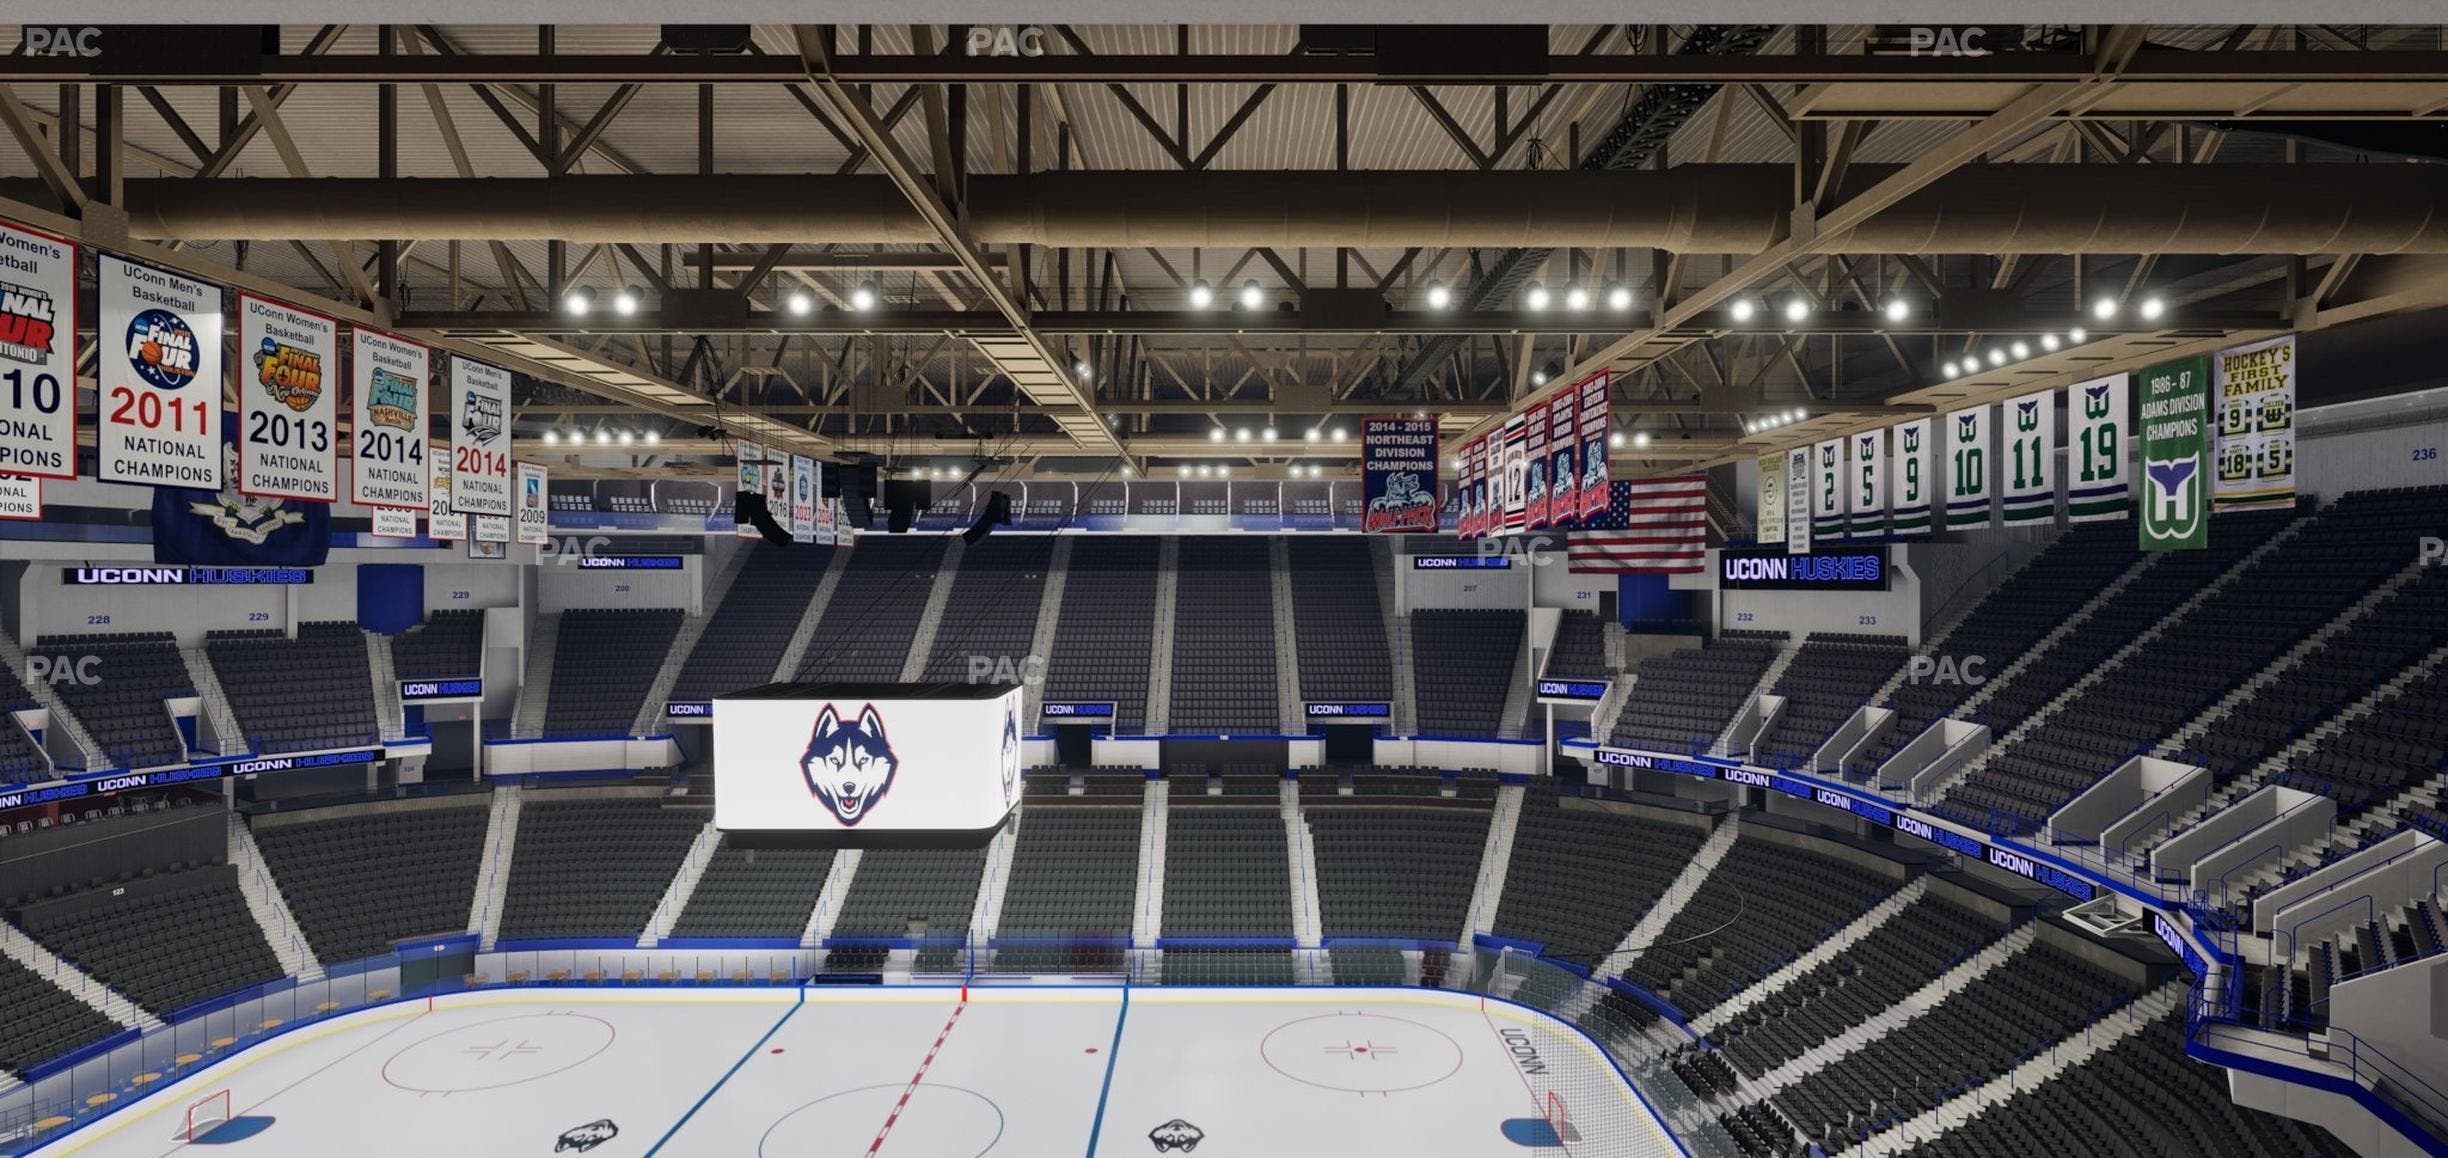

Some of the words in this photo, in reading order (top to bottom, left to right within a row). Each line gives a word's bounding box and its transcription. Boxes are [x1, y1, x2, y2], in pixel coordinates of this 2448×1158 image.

[123, 264, 166, 287] UConn
[169, 277, 203, 297] Men's
[132, 286, 195, 312] Basketball
[250, 302, 284, 320] UConn
[286, 312, 328, 333] Women's
[148, 324, 192, 351] FINAL
[265, 323, 314, 345] Basketball
[360, 334, 388, 349] UConn
[389, 342, 422, 359] Women's
[280, 347, 320, 373] FINAL
[372, 351, 412, 370] Basketball
[2224, 346, 2291, 373] HOCKEY'S
[2230, 364, 2283, 383] FIRST
[2223, 375, 2289, 397] FAMILY
[110, 386, 208, 436] 2011
[2141, 399, 2168, 420] ADAMS
[2169, 392, 2205, 416] DIVISION
[1369, 422, 1396, 432] 2014
[1405, 422, 1431, 432] 2015
[2230, 408, 2240, 428] 9
[250, 410, 328, 452] 2013
[1366, 435, 1434, 445] NORTHEAST
[2146, 418, 2198, 442] CHAMPIONS
[124, 435, 206, 459] NATIONAL
[360, 429, 423, 465] 2014
[1375, 448, 1425, 458] DIVISION
[2080, 422, 2117, 482] 19
[2412, 448, 2437, 461] 236
[260, 453, 323, 473] NATIONAL
[456, 446, 506, 478] 2014
[1367, 461, 1434, 471] CHAMPIONS
[2013, 436, 2043, 489] 11
[2226, 453, 2244, 473] 18
[2269, 449, 2280, 469] 5
[114, 459, 213, 483] CHAMPIONS
[369, 467, 419, 484] NATIONAL
[1906, 457, 1919, 501] 9
[1955, 448, 1982, 496] 10
[252, 474, 329, 494] CHAMPIONS
[463, 479, 503, 494] NATIONAL
[1508, 464, 1521, 502] 12
[1825, 472, 1834, 511] 2
[1863, 465, 1873, 506] 5
[362, 485, 423, 503] CHAMPIONS
[459, 496, 507, 511] CHAMPIONS
[520, 509, 545, 523] 2009
[583, 558, 625, 567] UCONN
[1418, 558, 1457, 567] UCONN
[1726, 558, 1787, 580] UCONN
[1791, 556, 1880, 580] HUSKIES
[78, 568, 182, 583] UCONN
[189, 569, 306, 583] HUSKIES
[452, 591, 470, 599] 229
[88, 616, 111, 624] 228
[249, 613, 269, 621] 229
[1737, 613, 1753, 621] 232
[1859, 616, 1876, 625] 233
[404, 683, 438, 695] UCONN
[1540, 682, 1568, 694] UCONN
[670, 705, 704, 714] UCONN
[1045, 705, 1075, 714] UCONN
[1309, 705, 1343, 714] UCONN
[233, 759, 292, 774] UCONN
[1599, 751, 1651, 768] UCONN
[98, 775, 146, 791] UCONN
[1725, 768, 1770, 787] UCONN
[1817, 789, 1851, 811] UCONN
[1897, 815, 1932, 840] UCONN
[1989, 848, 2034, 878] UCONN
[2035, 864, 2092, 902] HUSKIES
[2155, 914, 2183, 958] UCONN
[1500, 1028, 1549, 1076] UCONN
